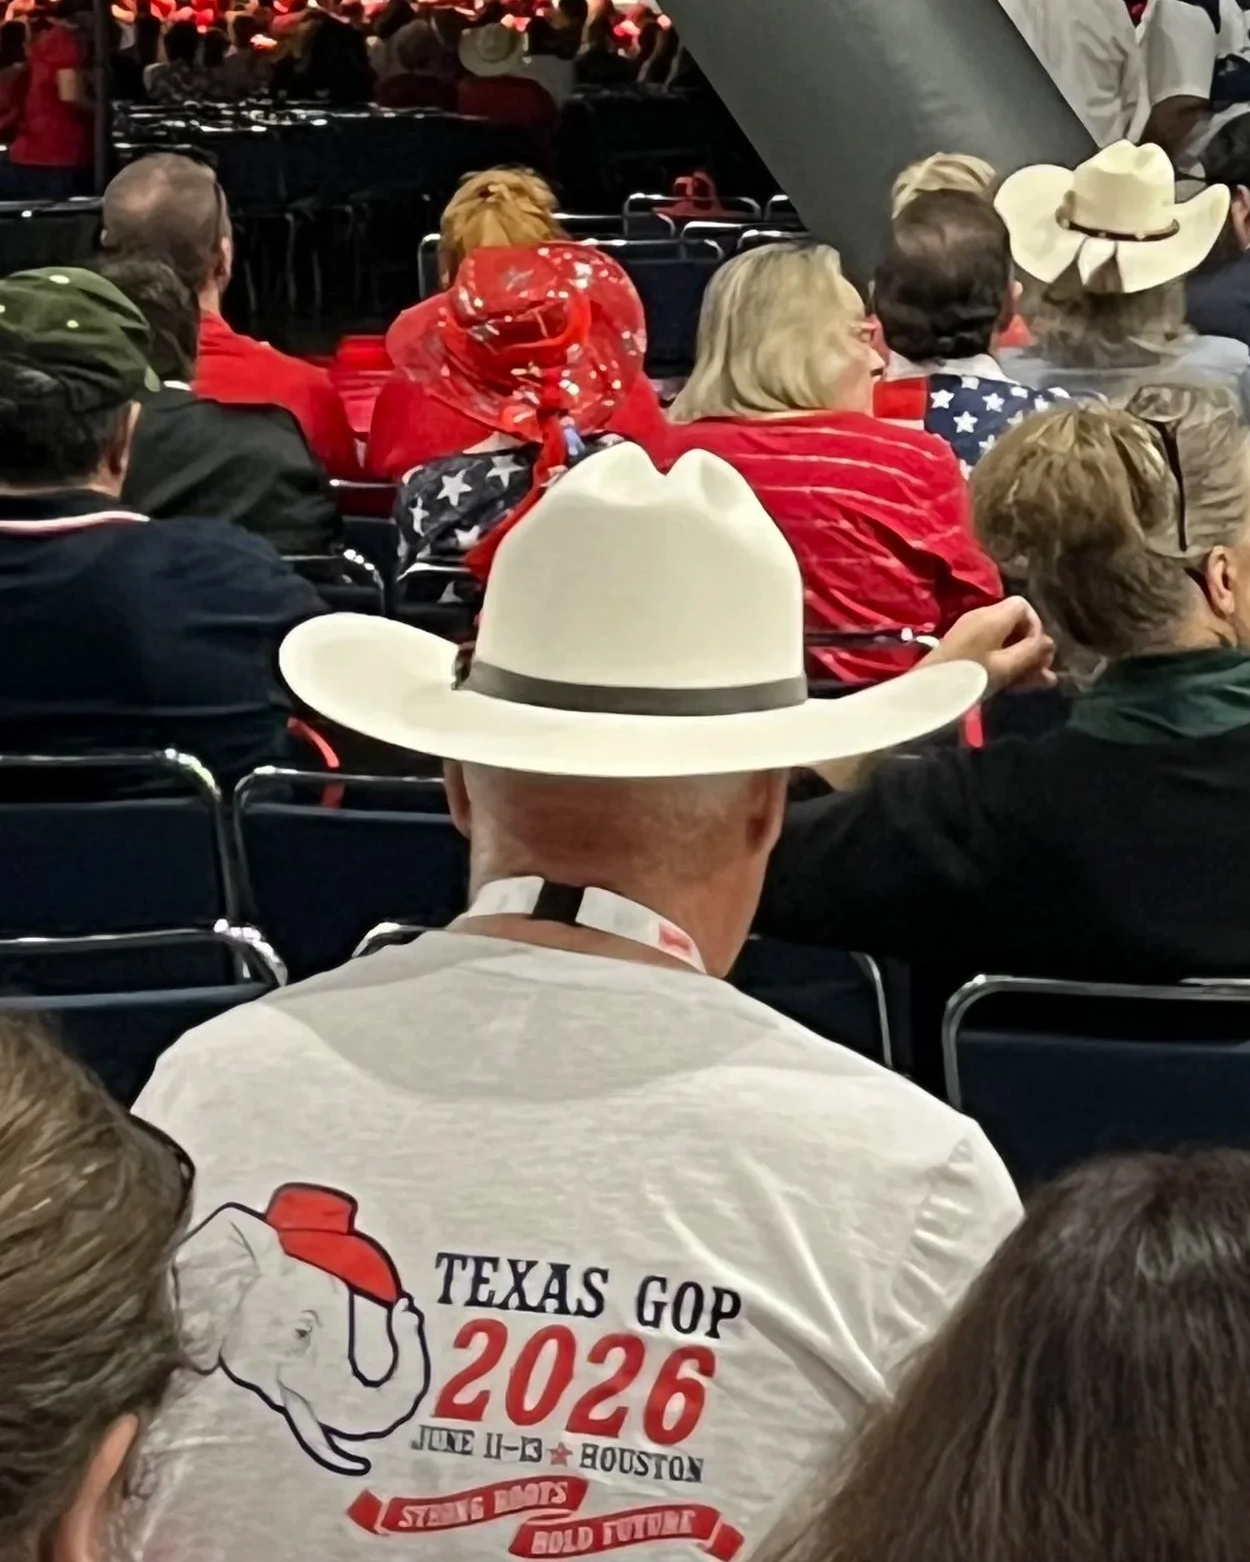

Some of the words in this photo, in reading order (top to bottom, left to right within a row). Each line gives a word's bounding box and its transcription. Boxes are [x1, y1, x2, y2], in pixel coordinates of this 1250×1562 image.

[434, 1251, 609, 1319] TEXAS
[635, 1275, 743, 1339] GOP
[432, 1318, 716, 1445] 2026
[410, 1424, 476, 1456] JUNE
[579, 1442, 704, 1482] HOUSTON
[530, 1526, 594, 1555] BOLD
[601, 1509, 697, 1546] FUTURE
